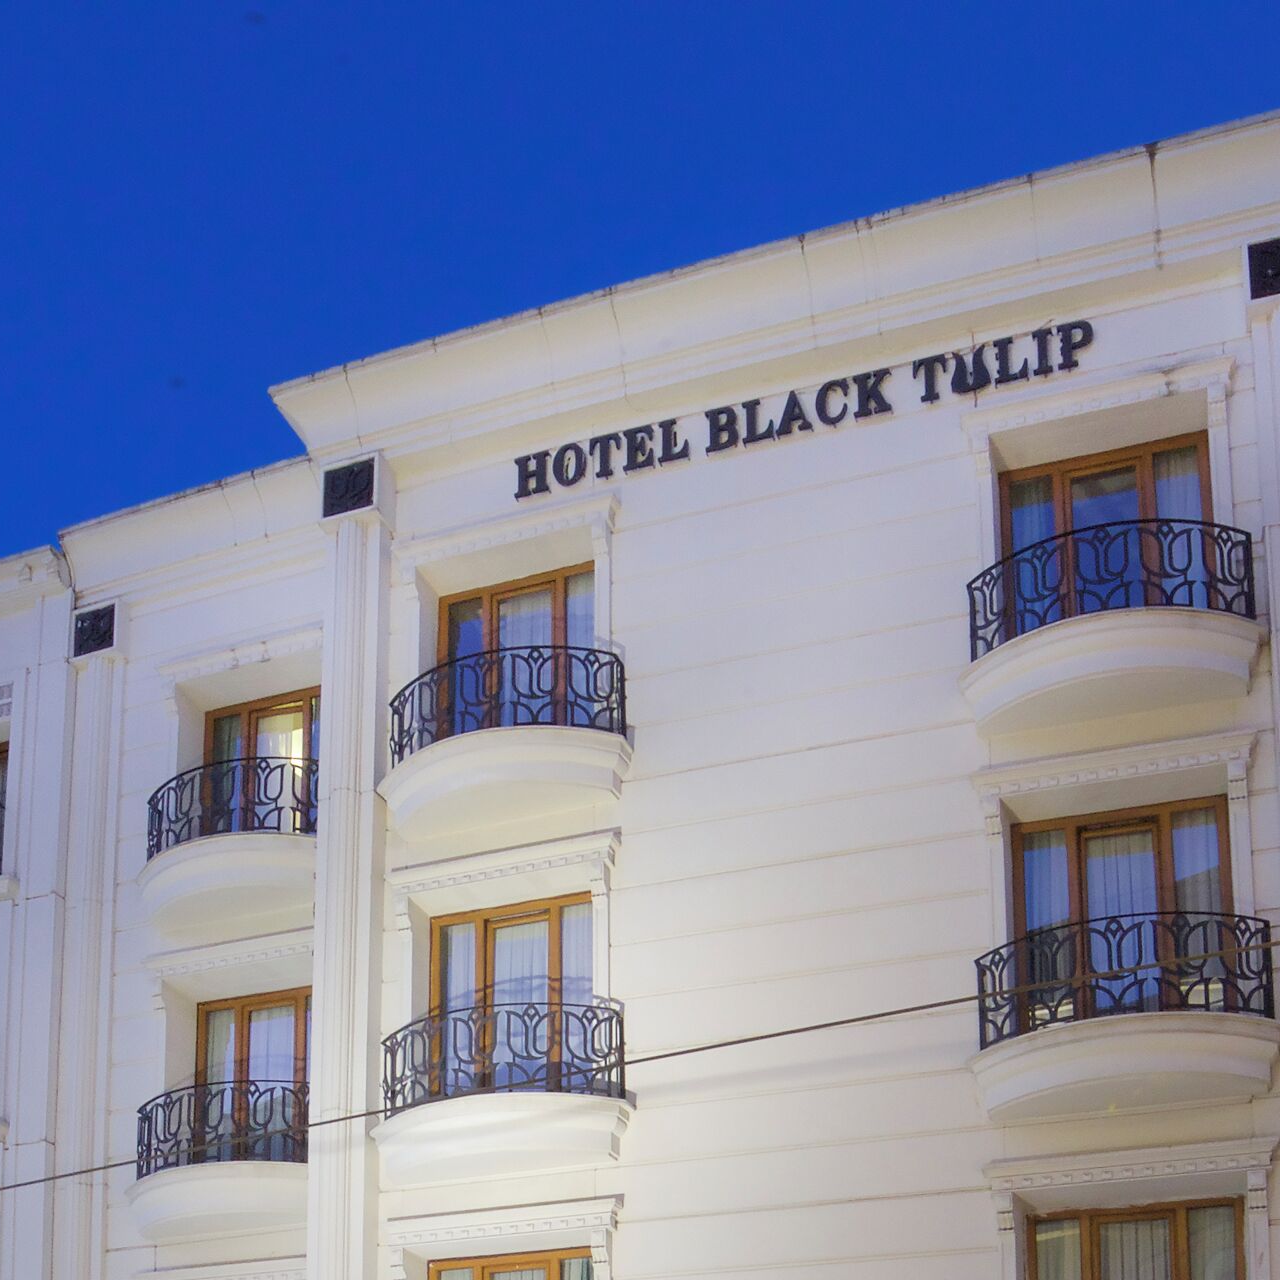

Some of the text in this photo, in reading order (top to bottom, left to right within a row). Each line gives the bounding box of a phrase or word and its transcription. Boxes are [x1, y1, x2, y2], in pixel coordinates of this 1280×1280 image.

[514, 319, 1094, 500] HOTEL BLACK TULIP
